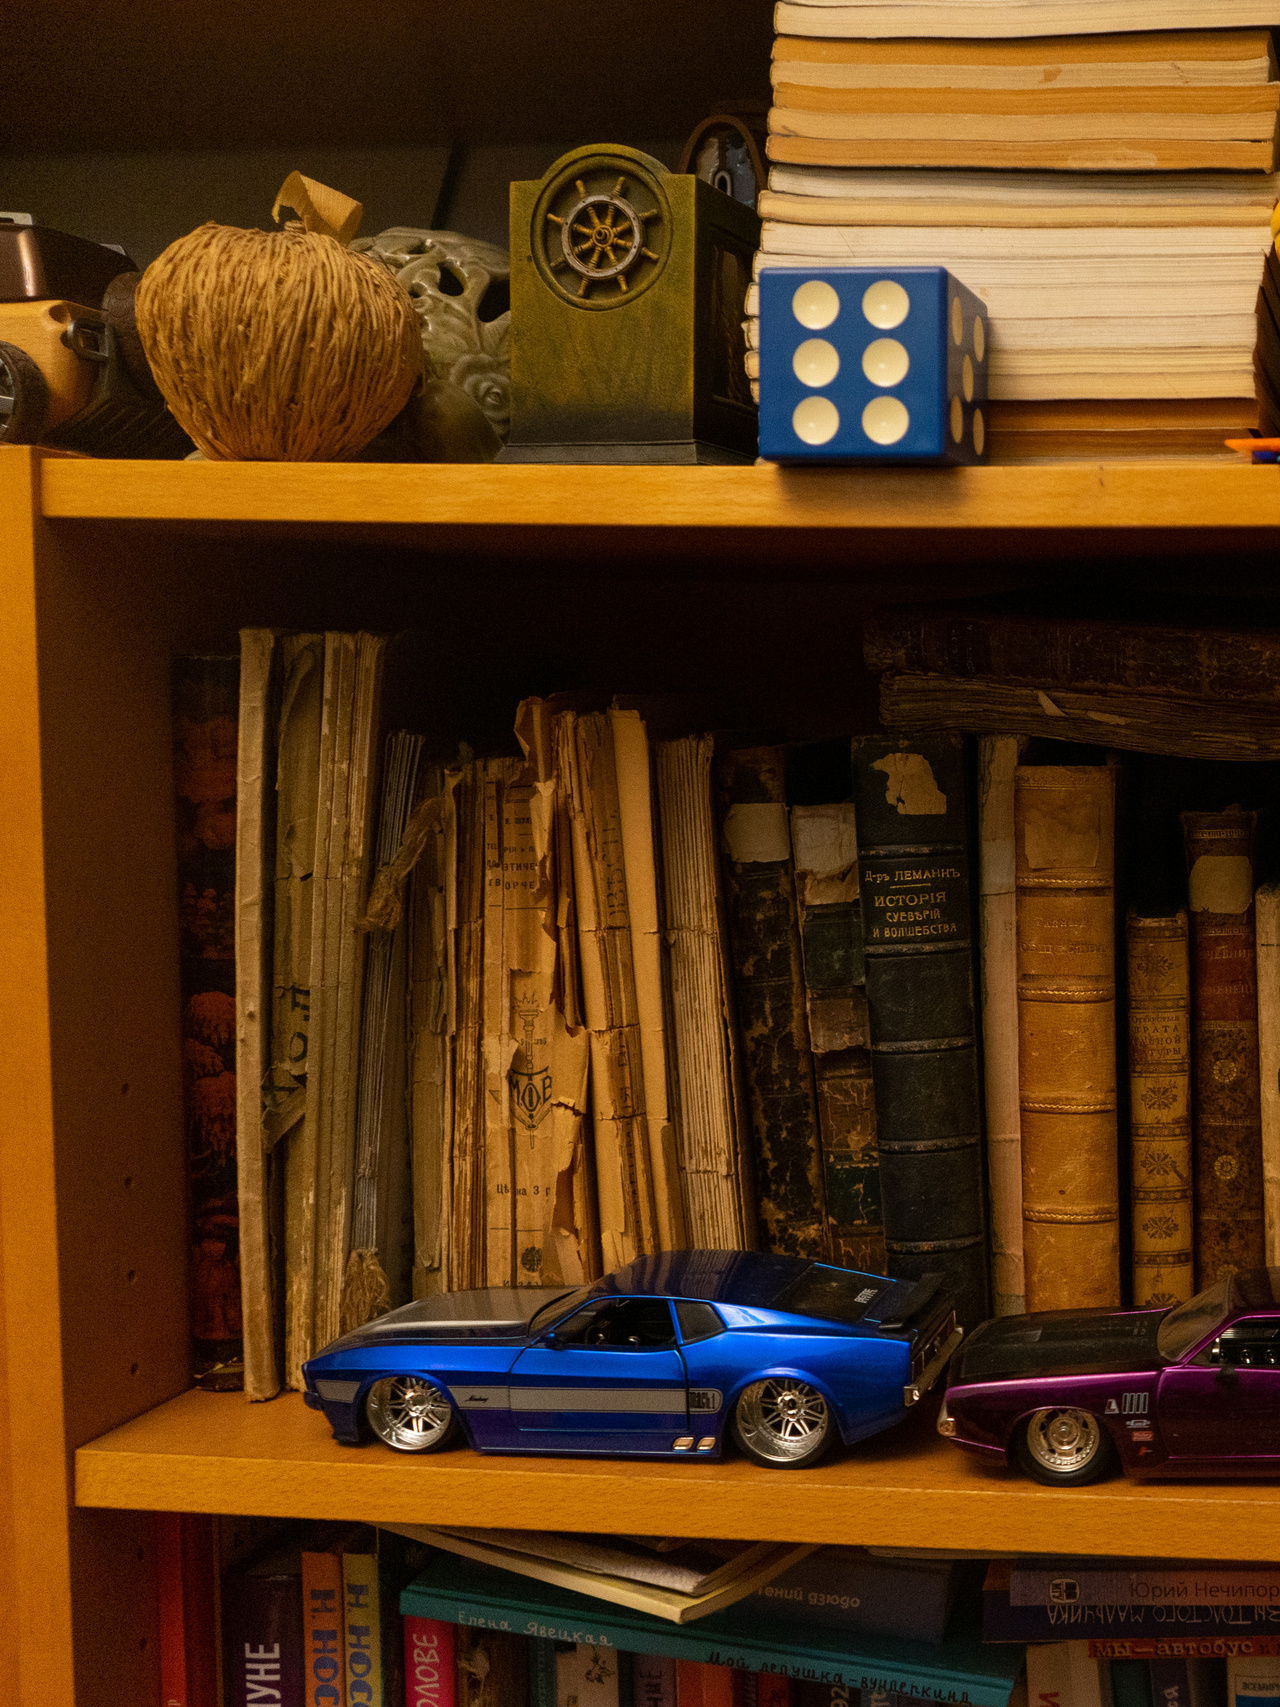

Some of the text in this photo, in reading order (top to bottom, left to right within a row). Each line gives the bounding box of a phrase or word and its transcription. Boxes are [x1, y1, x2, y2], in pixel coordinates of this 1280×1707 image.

[894, 868, 961, 881] ЛЕМАННЪ
[874, 891, 947, 908] ИСТОРІЯ
[873, 922, 957, 938] И ВОЛШЕБСТВА
[808, 1591, 860, 1609] дзюдо
[1131, 1580, 1188, 1602] Юрий
[458, 1611, 613, 1648] Елена Явецкая
[349, 1625, 373, 1707] НОС
[705, 1652, 749, 1671] Мой
